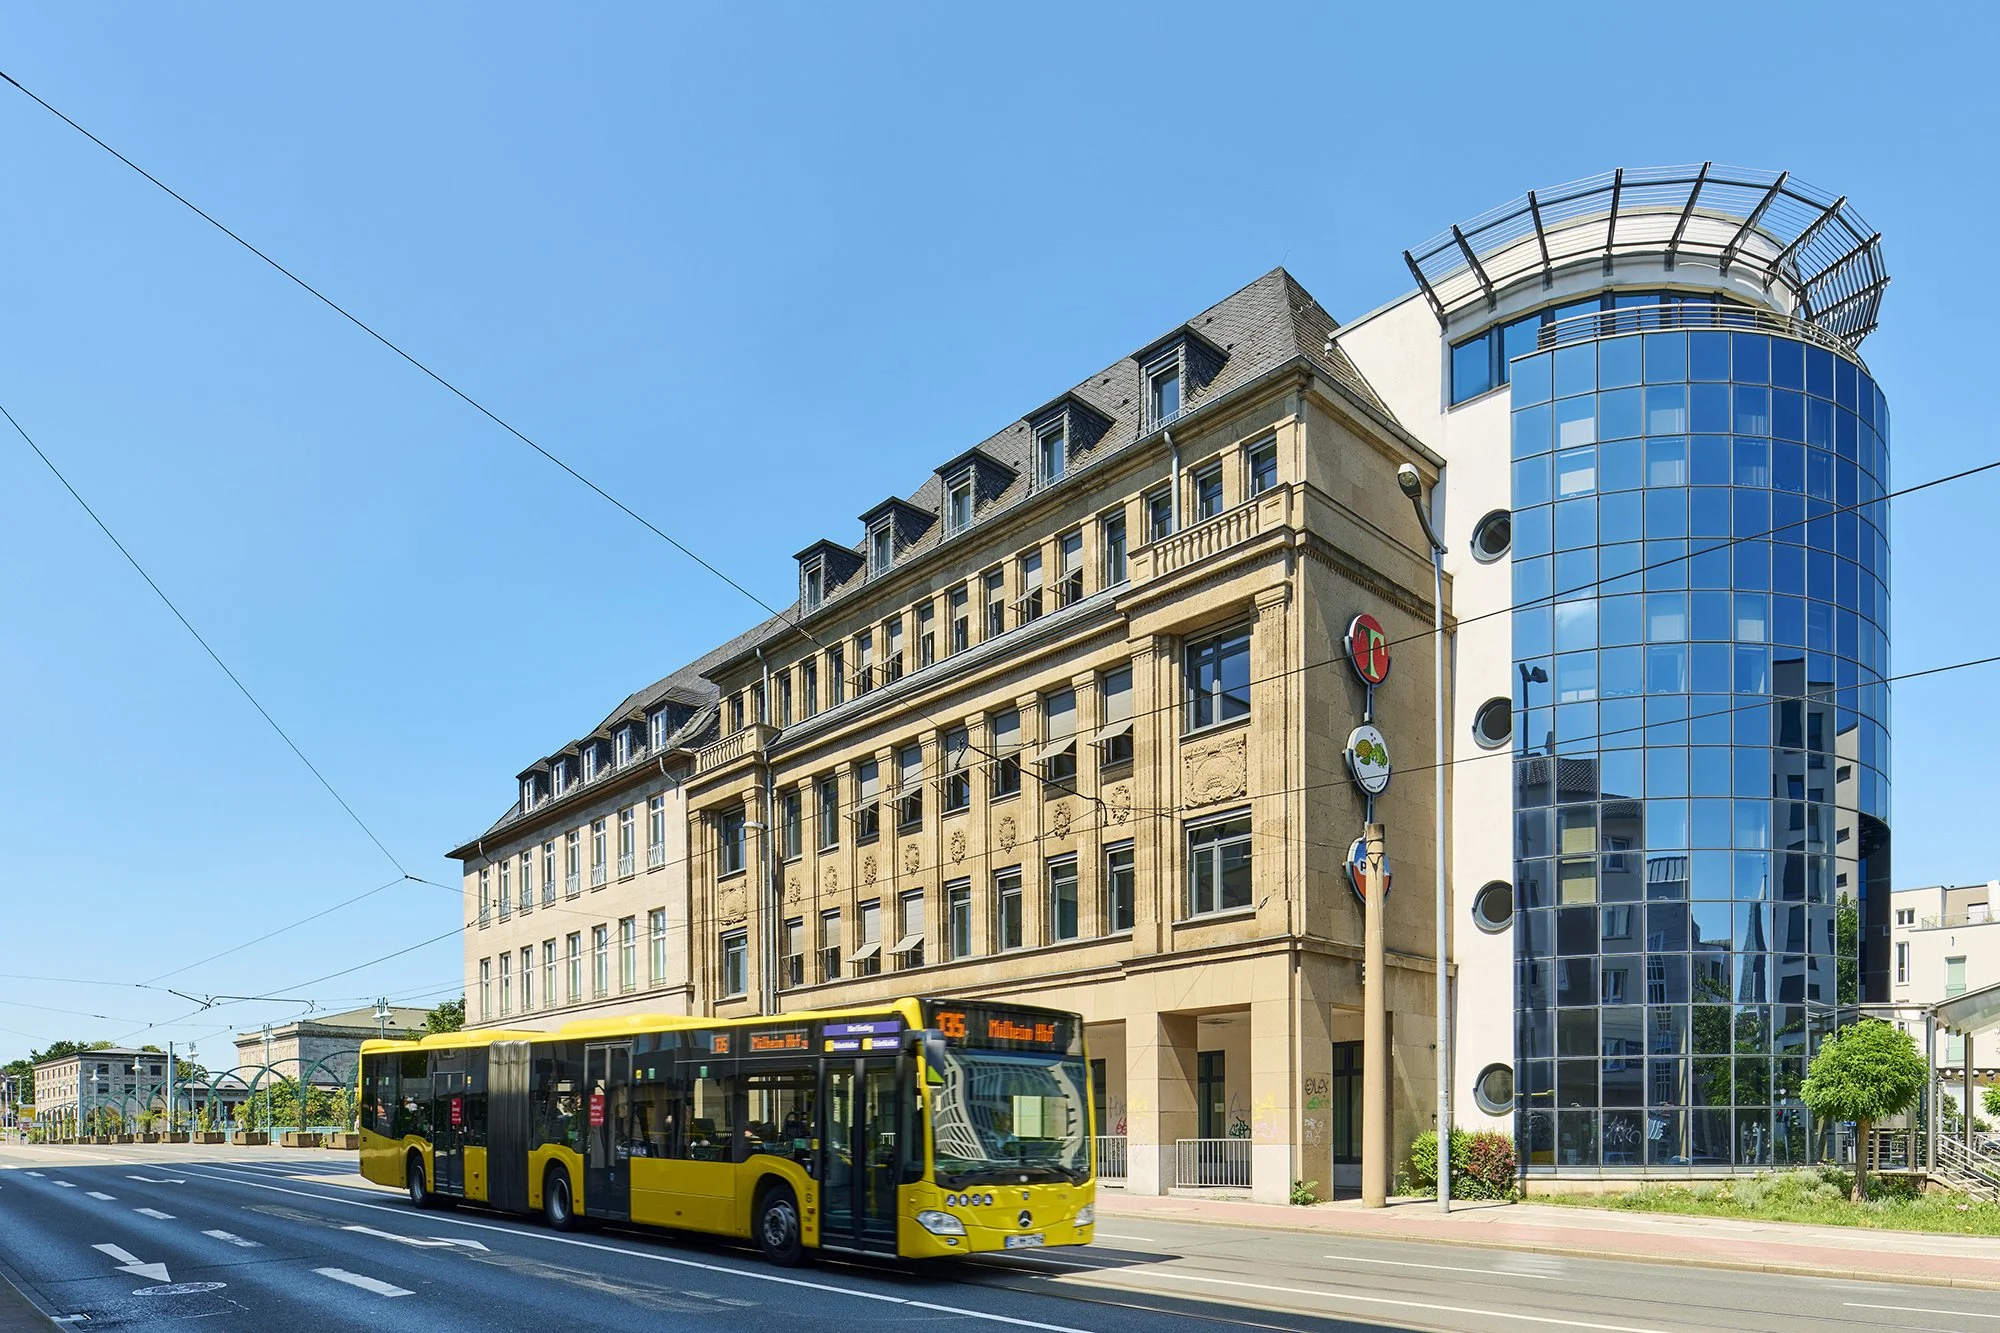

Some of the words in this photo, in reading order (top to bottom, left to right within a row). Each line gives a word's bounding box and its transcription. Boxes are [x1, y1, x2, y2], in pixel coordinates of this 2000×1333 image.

[1356, 622, 1386, 681] T
[936, 1011, 966, 1038] 135
[988, 1019, 1034, 1041] Mülheim
[1034, 1023, 1055, 1043] Hbf
[751, 1034, 785, 1050] Mülheim
